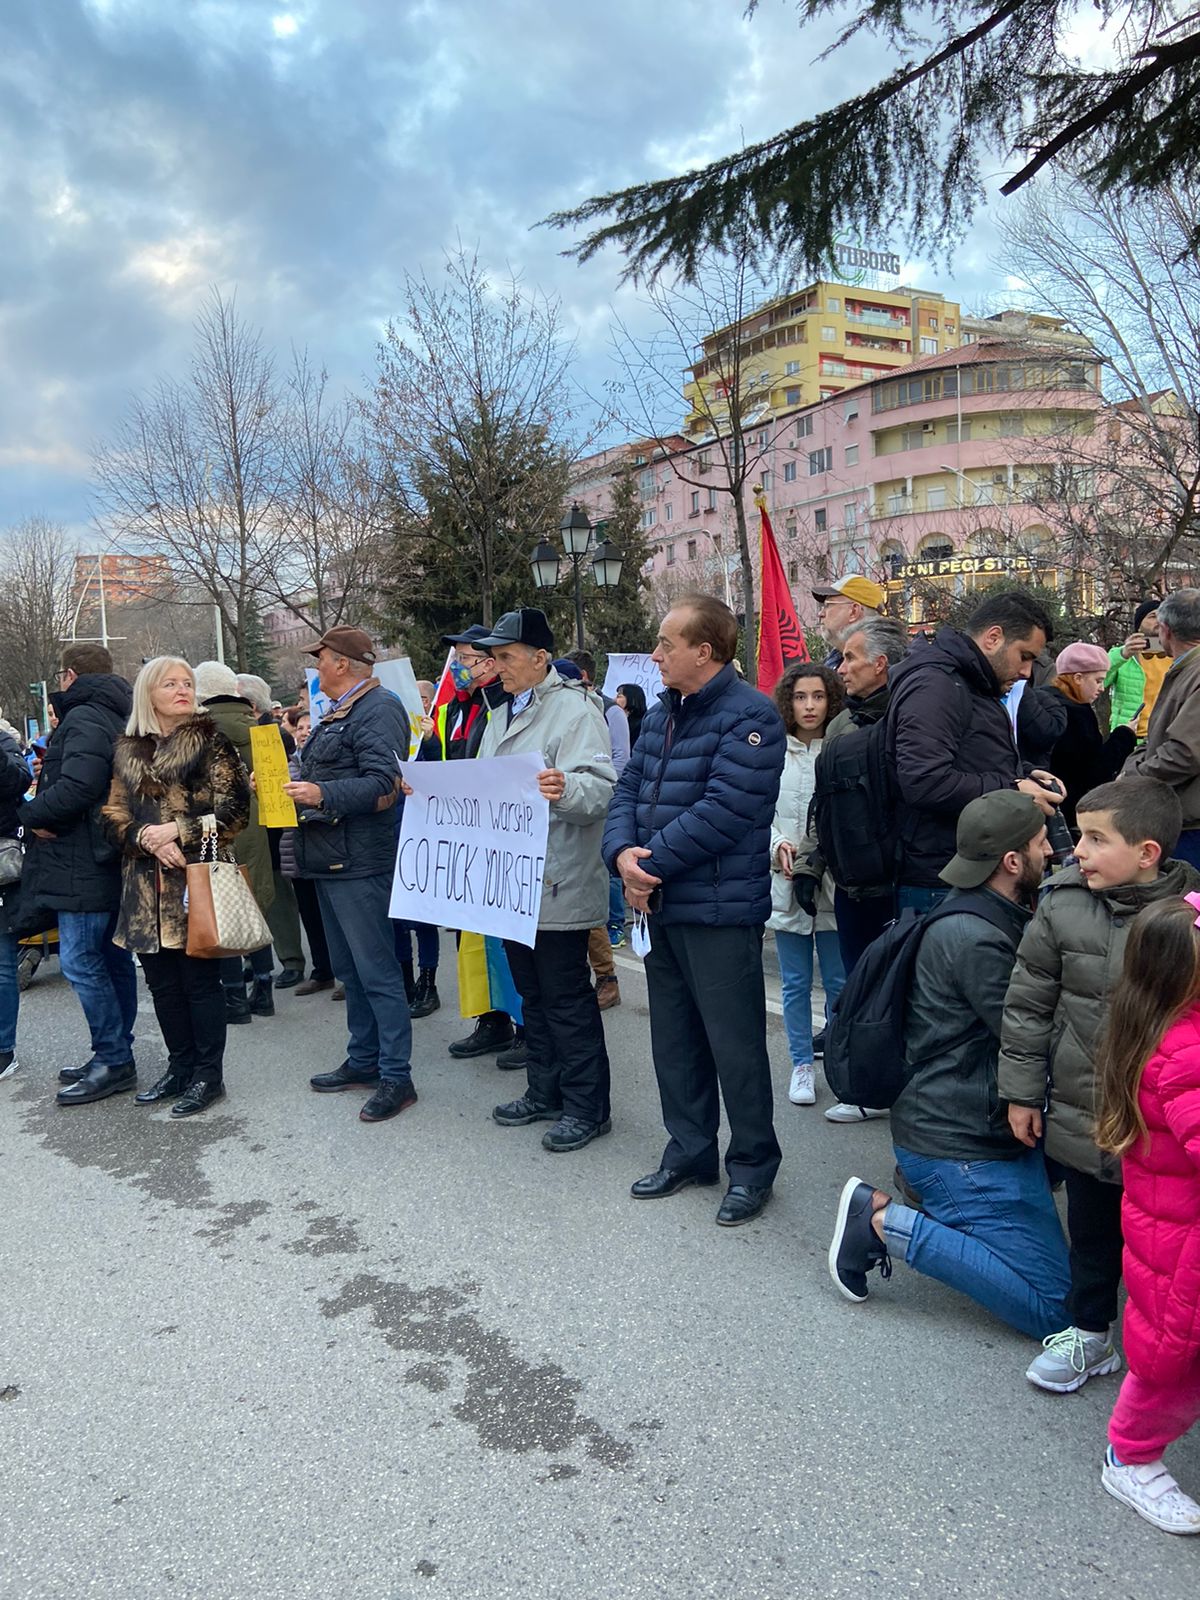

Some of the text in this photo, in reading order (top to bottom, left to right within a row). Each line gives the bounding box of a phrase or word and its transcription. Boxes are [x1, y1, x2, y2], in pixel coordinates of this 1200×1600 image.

[835, 243, 901, 275] TUBORG
[398, 837, 545, 919] GO FUCK YOURSELF
